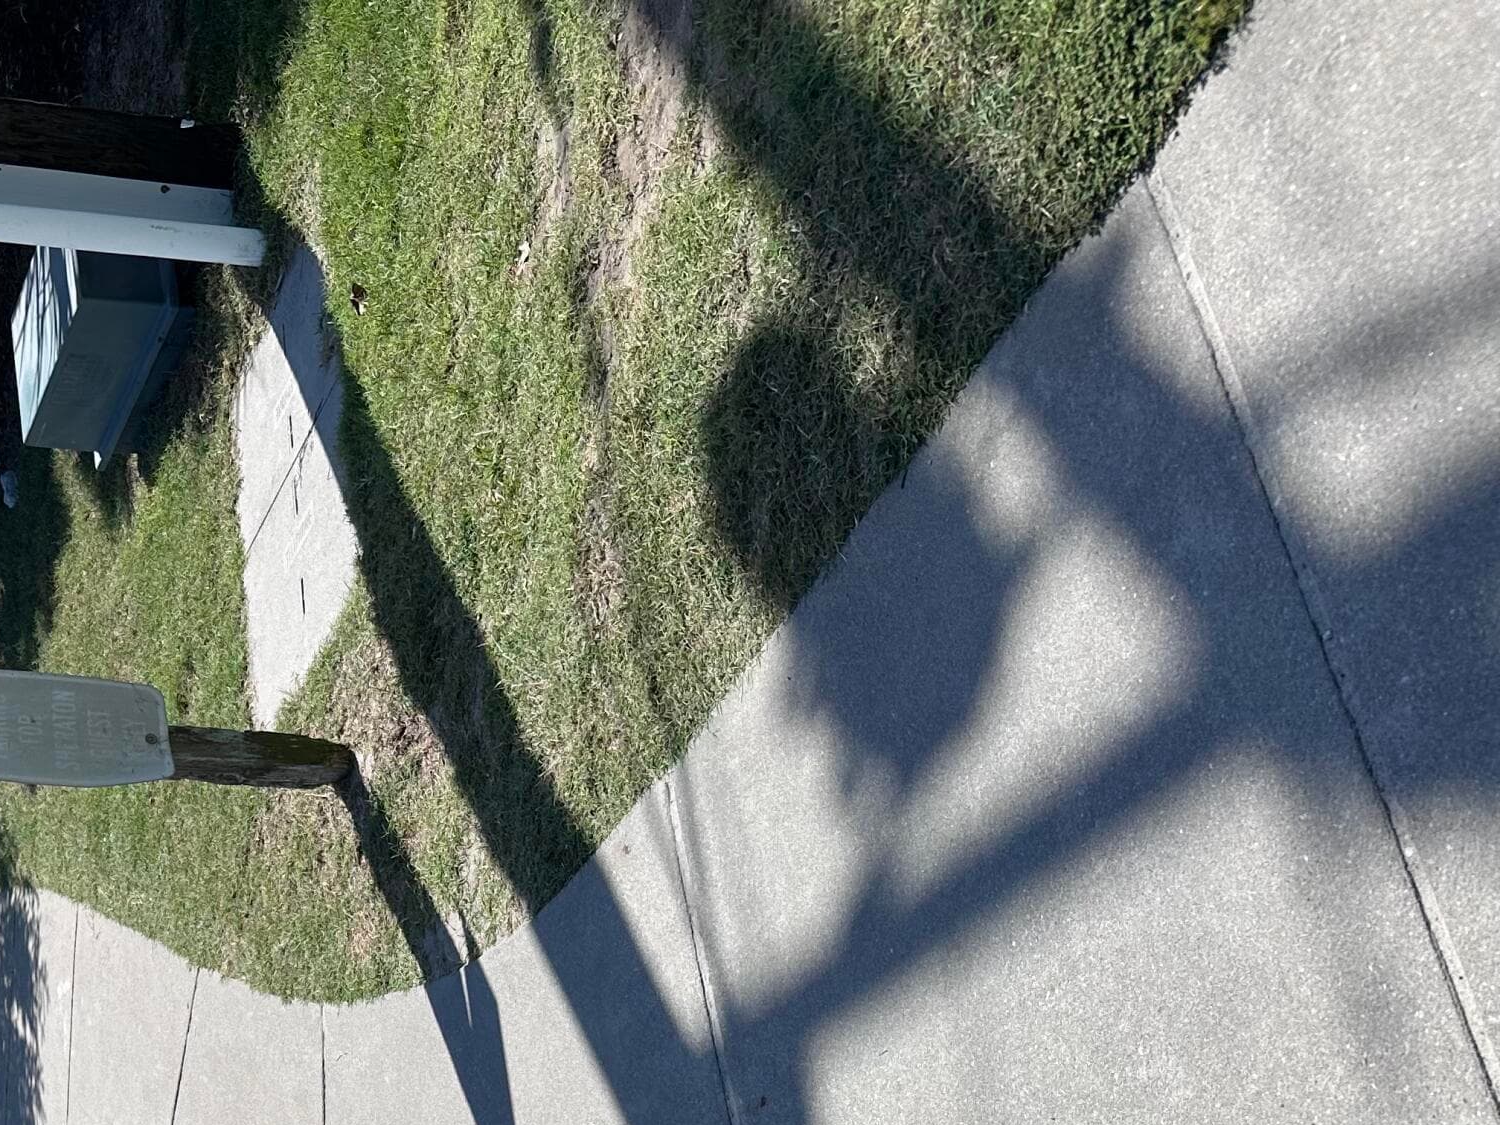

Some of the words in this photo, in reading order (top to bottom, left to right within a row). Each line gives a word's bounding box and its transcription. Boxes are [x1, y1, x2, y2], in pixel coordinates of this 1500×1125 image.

[18, 713, 44, 744] FOR
[51, 690, 80, 770] SHERATON
[86, 709, 112, 759] GUEST
